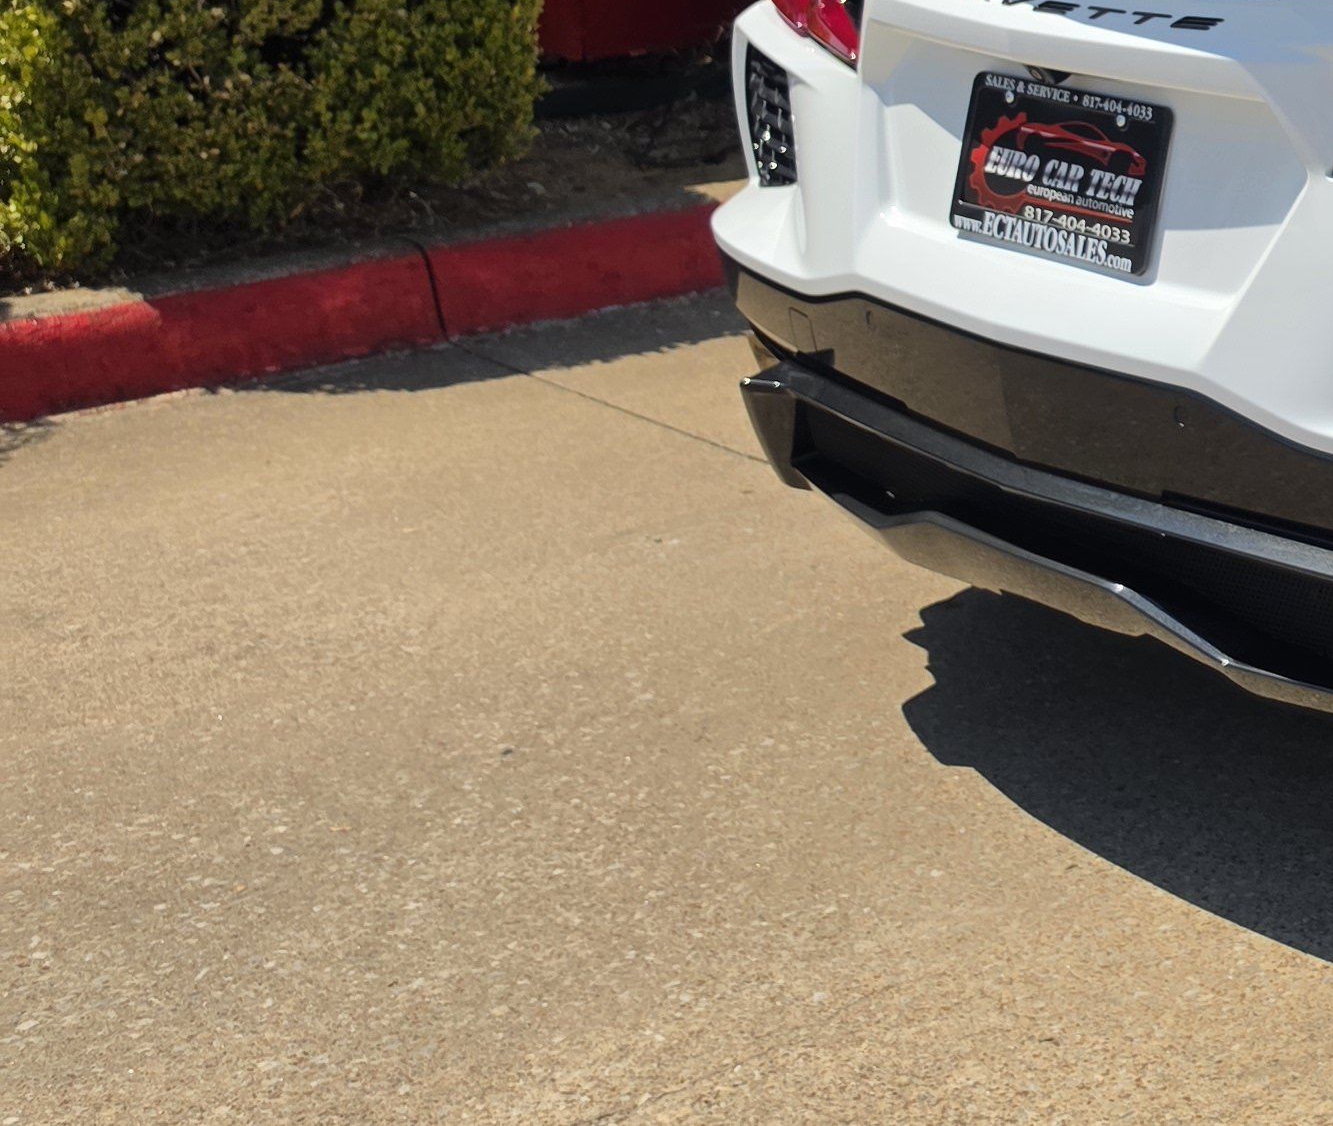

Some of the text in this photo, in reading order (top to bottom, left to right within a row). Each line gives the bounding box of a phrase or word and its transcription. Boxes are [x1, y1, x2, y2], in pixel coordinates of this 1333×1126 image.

[986, 75, 1016, 92] SALES
[1017, 81, 1025, 93] &
[1027, 83, 1070, 103] SERVICE
[984, 146, 1143, 205] EURO CAR TECH
[1027, 183, 1135, 219] european automotive
[954, 211, 1131, 272] www.ECTAUTOSALES.com
[1024, 205, 1131, 244] 817-404-4033
